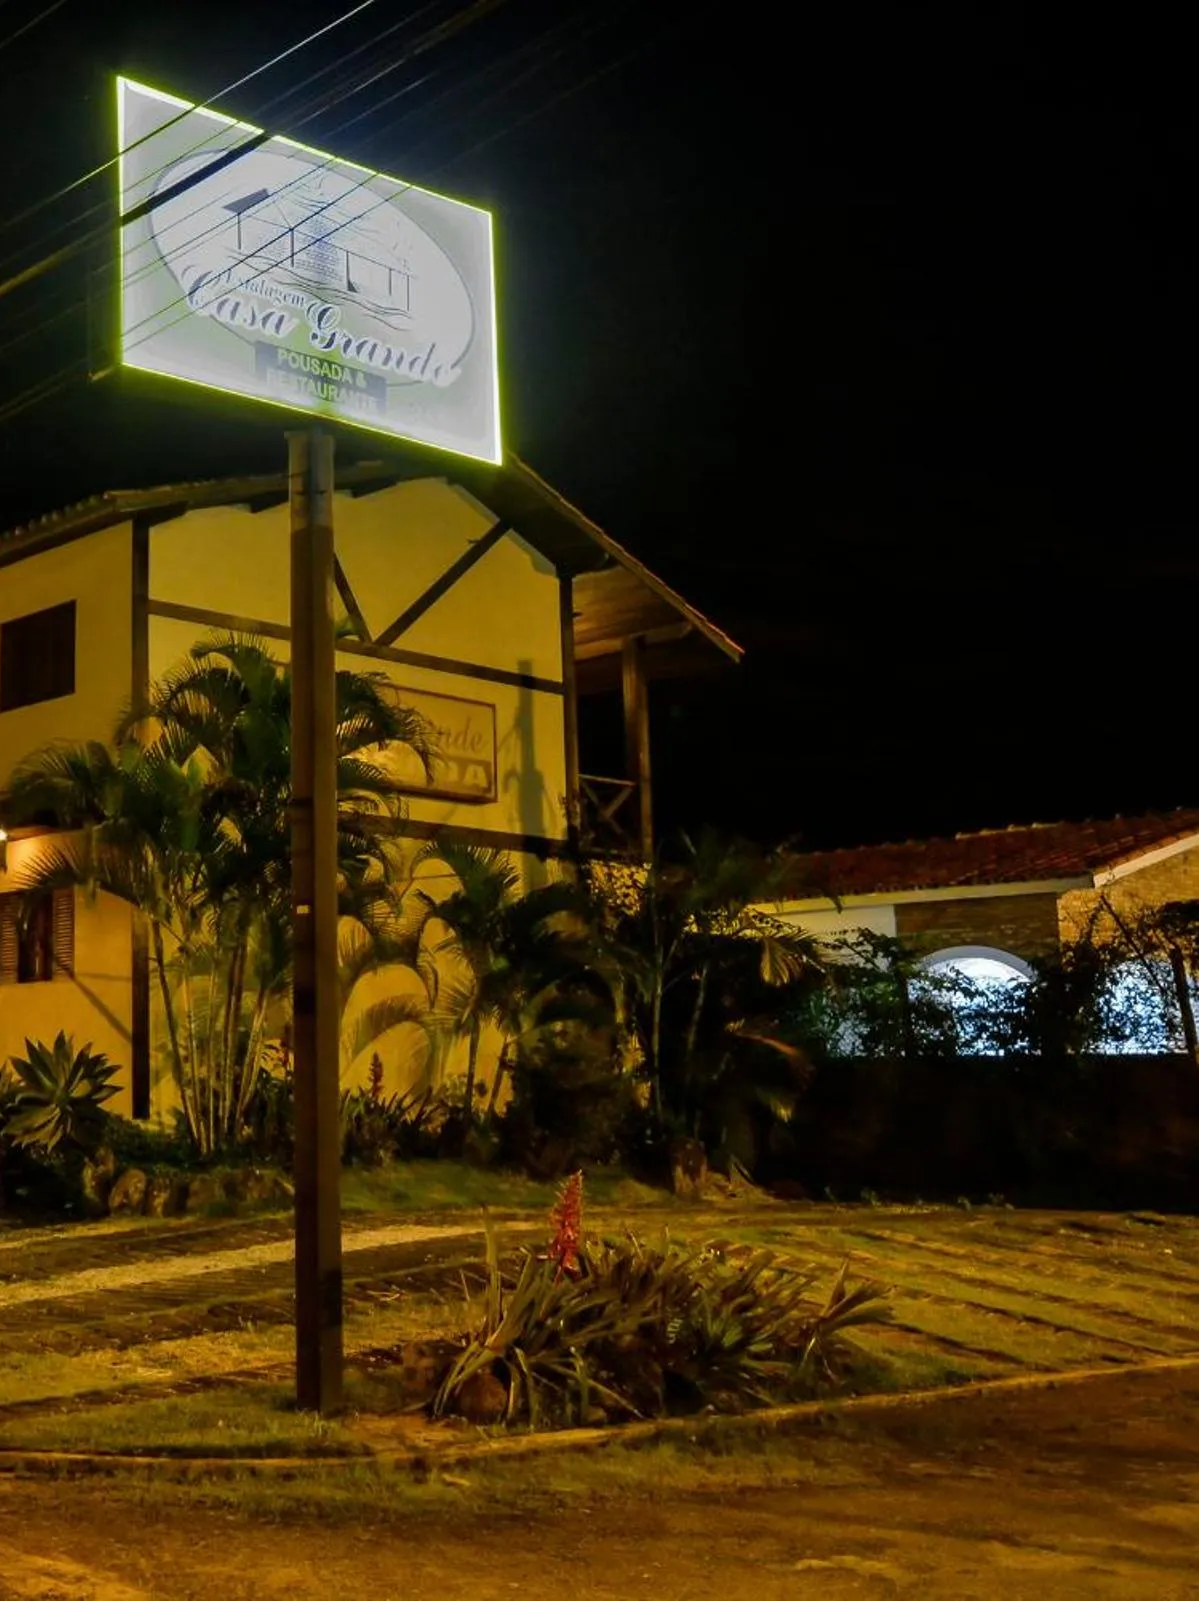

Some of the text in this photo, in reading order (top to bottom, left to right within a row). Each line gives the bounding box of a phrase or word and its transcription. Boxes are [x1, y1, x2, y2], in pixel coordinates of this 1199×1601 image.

[182, 265, 460, 387] Casa Grande
[277, 348, 352, 384] POUSADA
